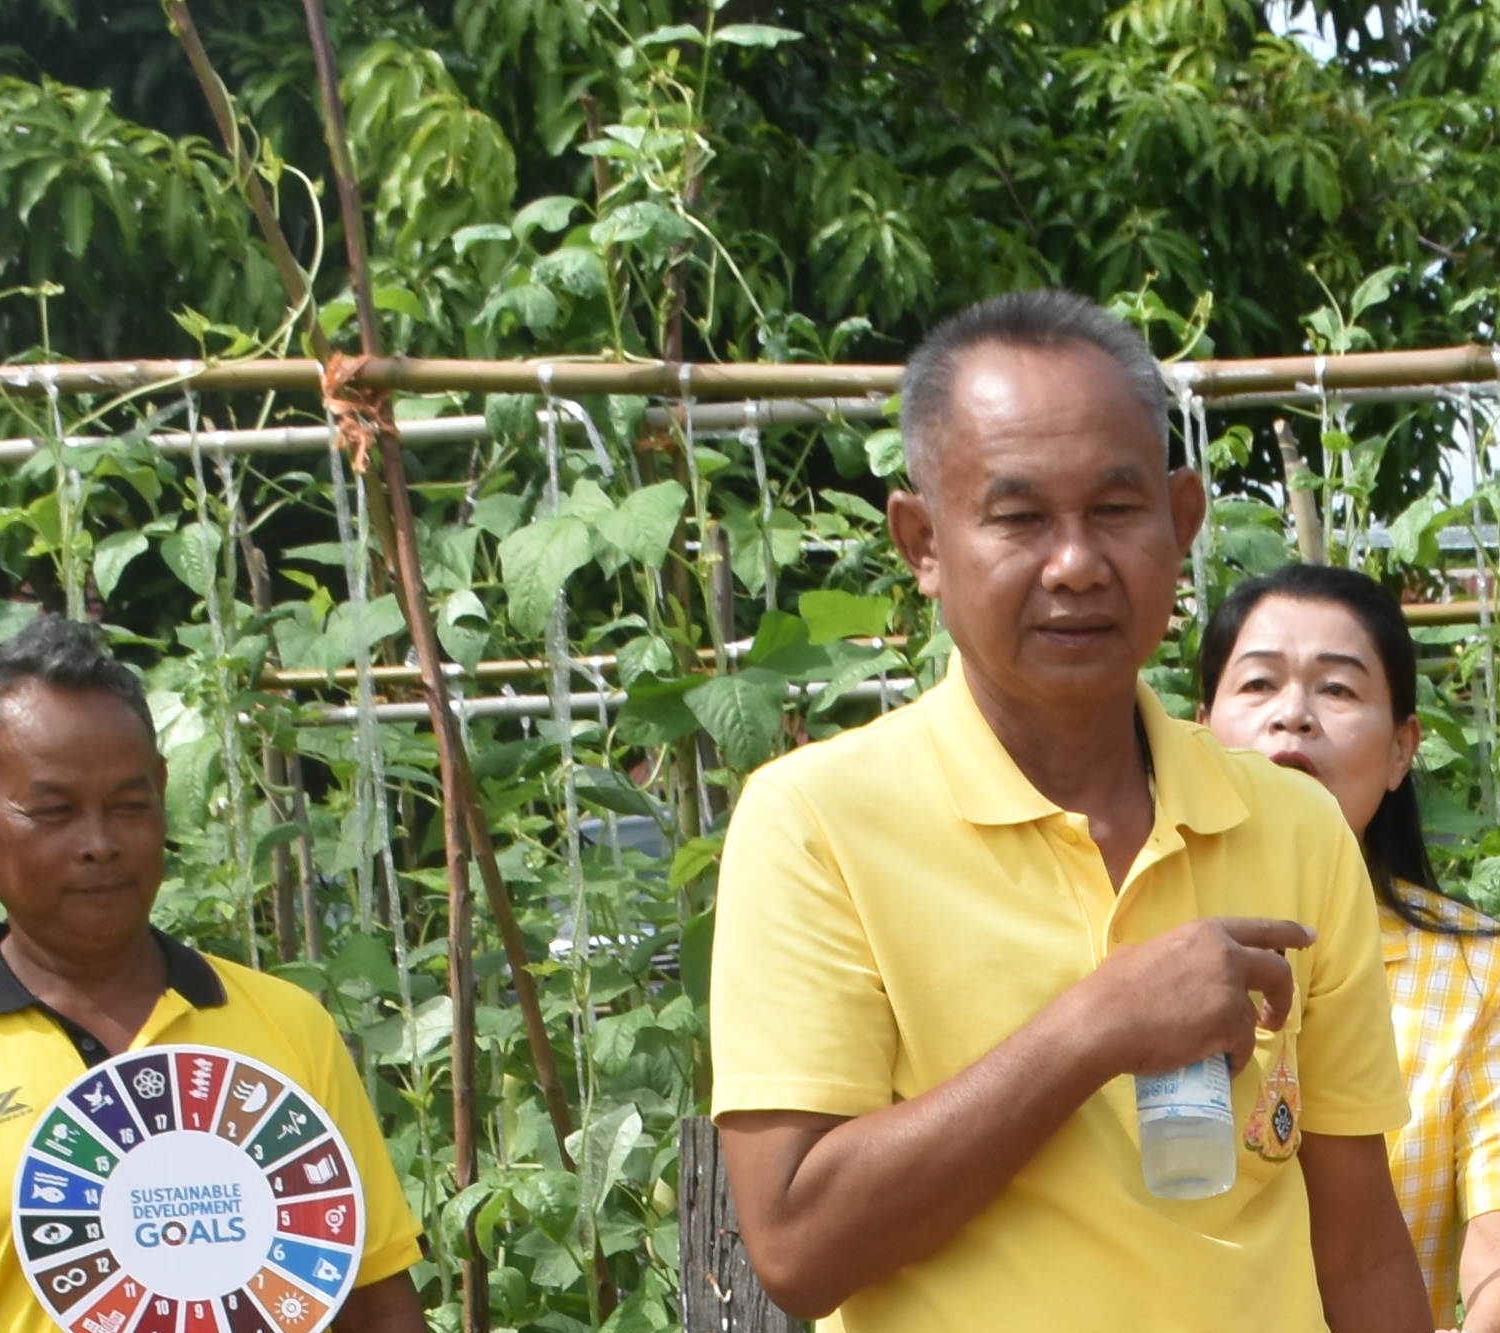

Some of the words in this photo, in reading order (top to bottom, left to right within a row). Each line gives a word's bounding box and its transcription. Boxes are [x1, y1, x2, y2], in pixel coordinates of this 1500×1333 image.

[154, 1113, 168, 1130] 17
[192, 1112, 200, 1128] 1
[119, 1128, 135, 1144] 16
[227, 1121, 237, 1138] 2
[253, 1144, 264, 1160] 3
[94, 1156, 110, 1172] 15
[274, 1177, 284, 1193] 4
[130, 1183, 242, 1205] SUSTAINABLE
[132, 1199, 242, 1220] DEVELOPMENT
[281, 1211, 291, 1226] 5
[85, 1222, 100, 1239] 13
[135, 1216, 247, 1248] GOALS
[273, 1243, 286, 1261] 6
[95, 1257, 110, 1273] 12
[255, 1274, 265, 1290] 7
[123, 1283, 136, 1298] 11
[154, 1300, 170, 1316] 10
[228, 1294, 238, 1310] 8
[194, 1303, 204, 1319] 9
